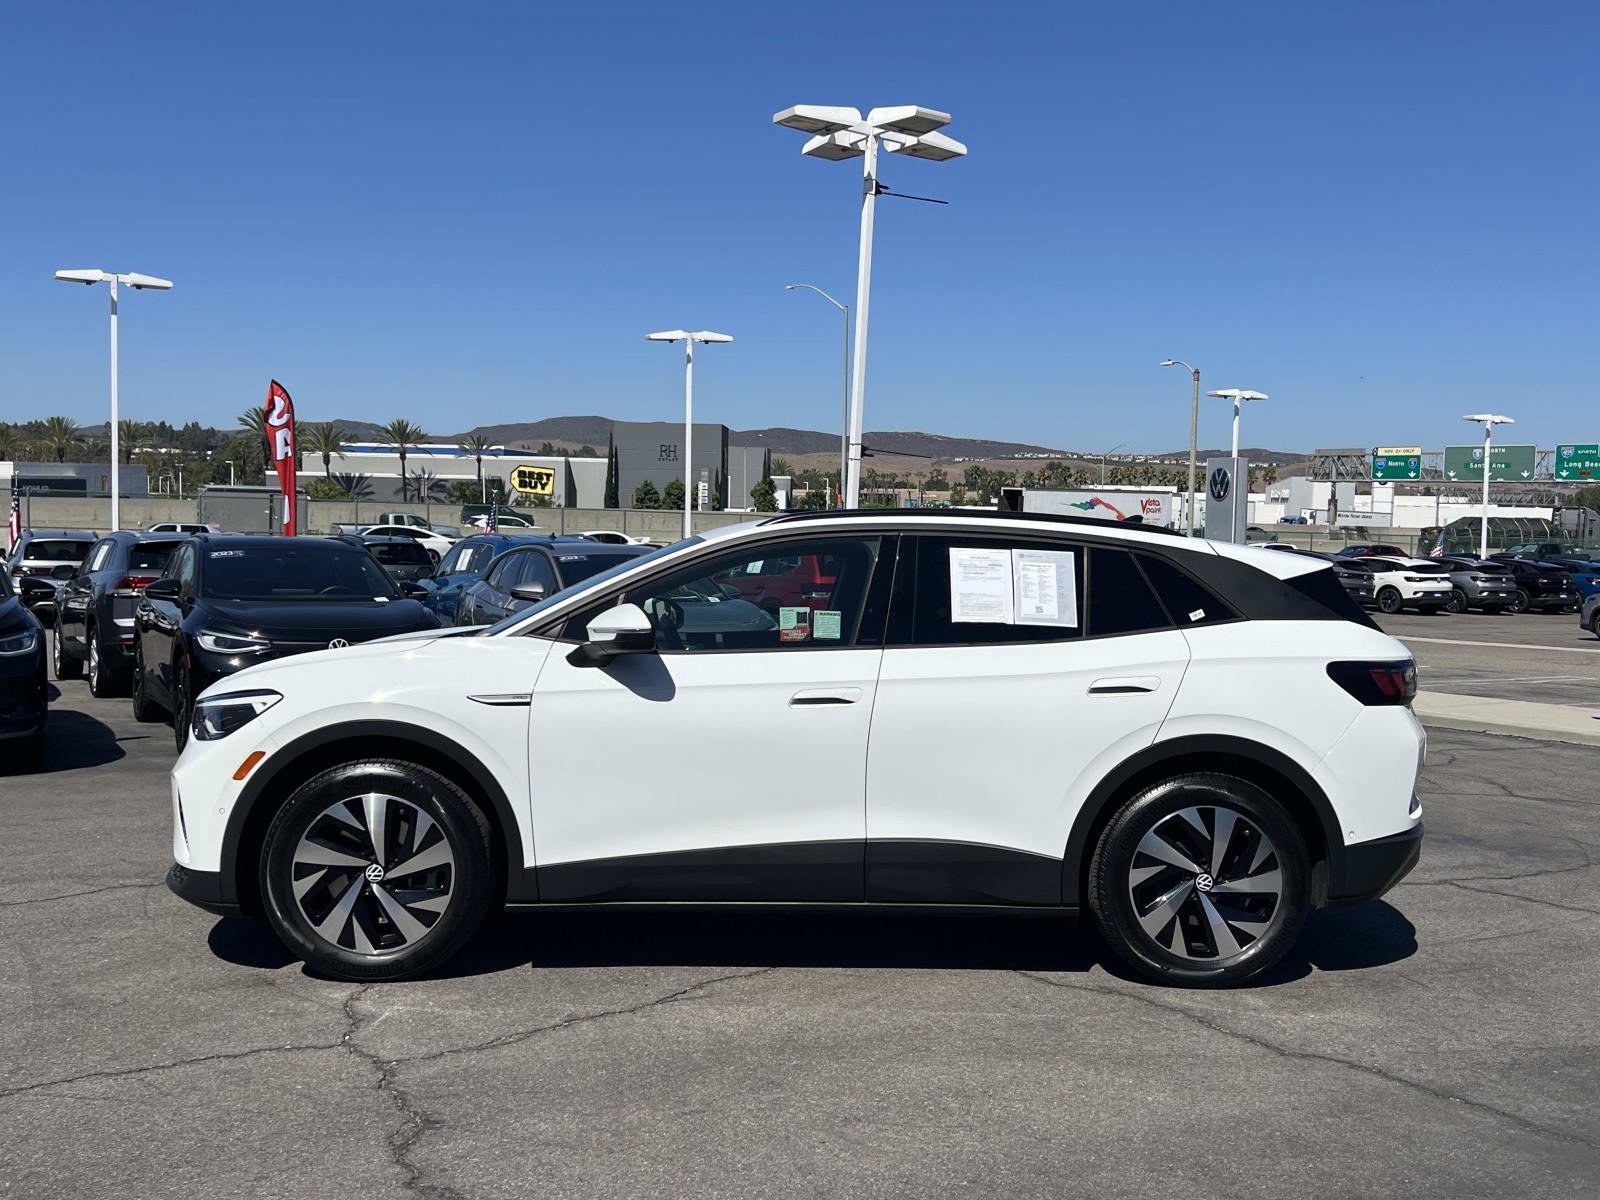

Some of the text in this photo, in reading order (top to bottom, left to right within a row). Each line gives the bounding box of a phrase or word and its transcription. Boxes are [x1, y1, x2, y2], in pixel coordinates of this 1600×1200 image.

[660, 445, 677, 457] RH
[1564, 461, 1582, 469] Long
[518, 470, 552, 482] BEST
[519, 479, 549, 491] BUY
[1210, 468, 1230, 500] VW
[1140, 498, 1161, 514] Vista
[1146, 507, 1162, 515] paint
